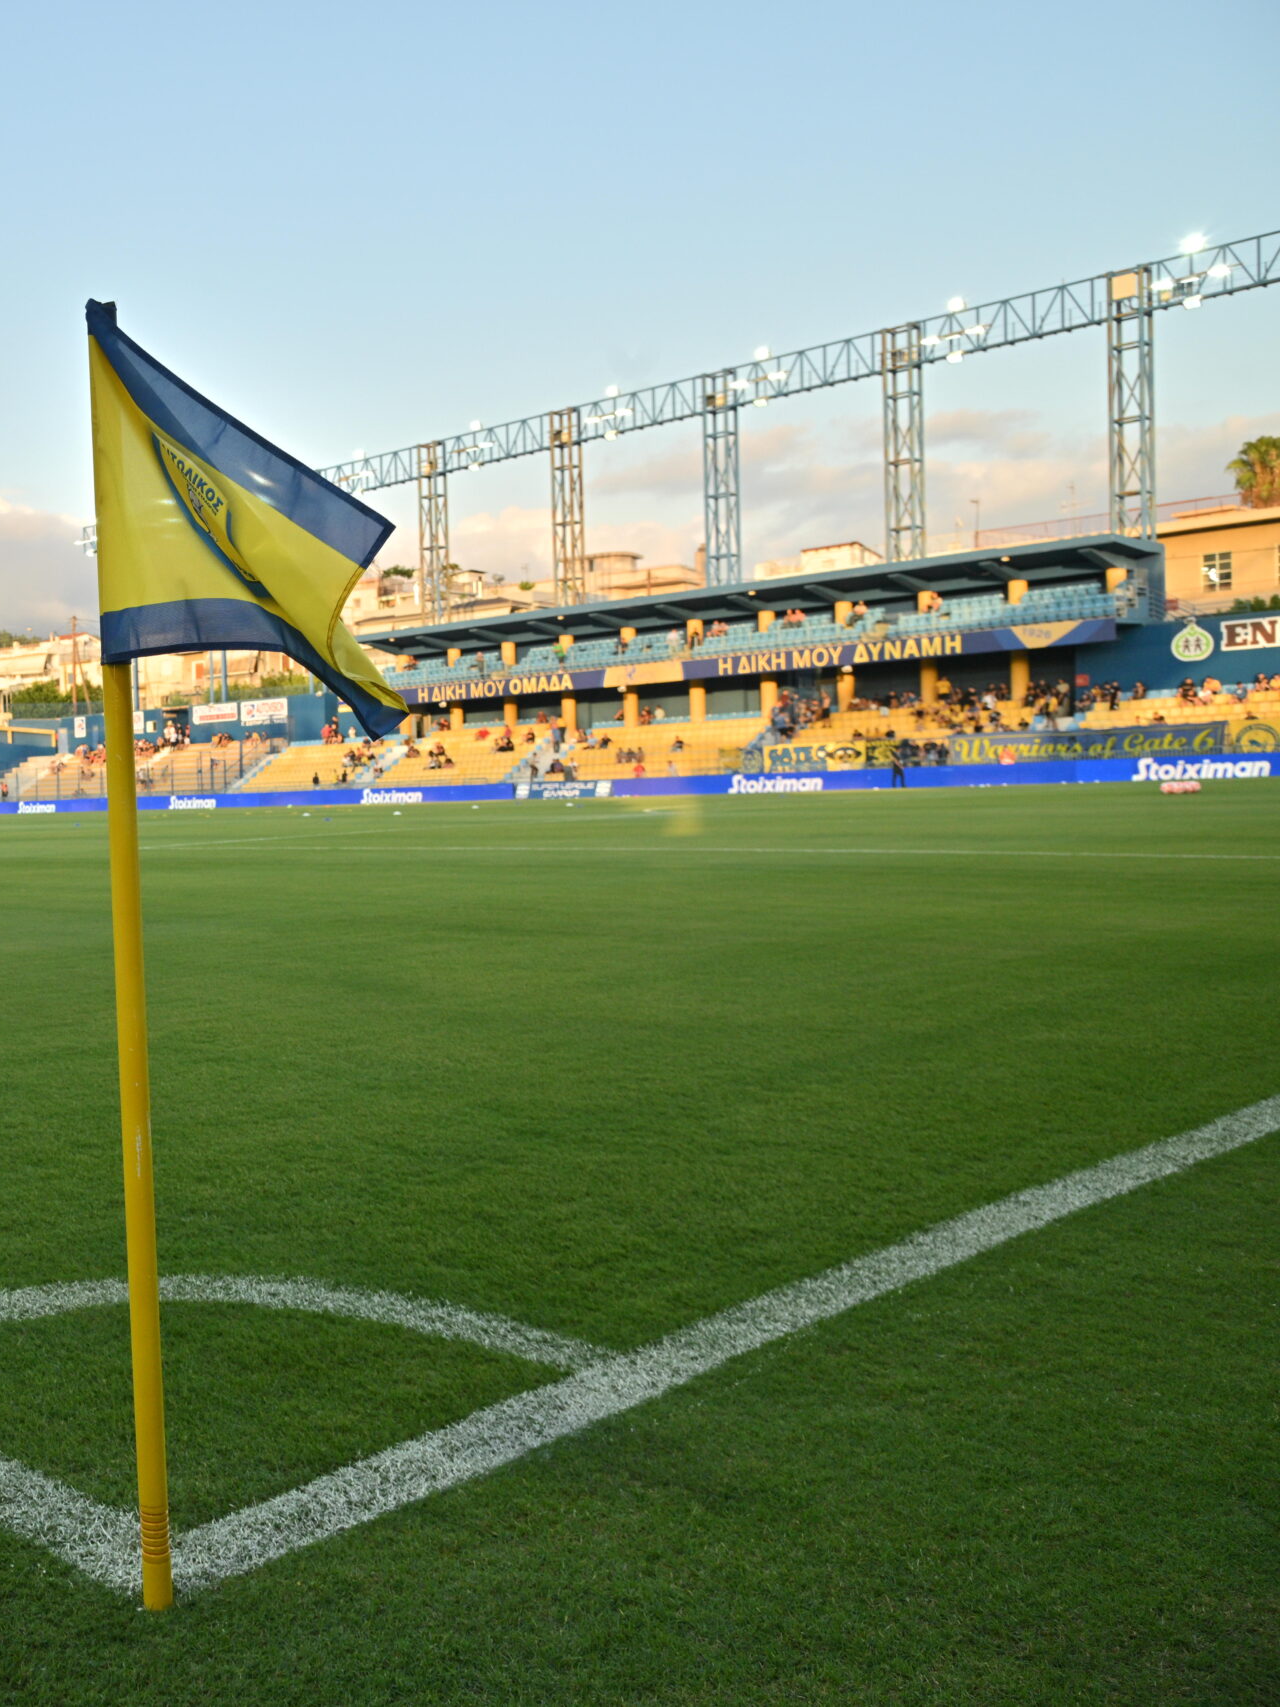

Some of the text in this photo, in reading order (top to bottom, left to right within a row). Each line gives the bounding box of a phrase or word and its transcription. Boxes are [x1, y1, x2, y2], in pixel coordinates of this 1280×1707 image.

[1225, 621, 1278, 648] EN
[718, 635, 962, 675] Η ΔΙΚΗ ΜΟΥ ΔΥΝΑΜΗ
[418, 674, 573, 703] Η ΔΙΚΗ ΜΟΥ ΟΜΑΔΑ
[955, 739, 1082, 762] Warriors
[1088, 735, 1117, 759] of
[1123, 732, 1179, 753] Gate
[1193, 728, 1215, 750] 6
[1132, 757, 1271, 781] Stoiximan
[728, 774, 823, 794] Stoiximan
[17, 801, 56, 814] Stoiximan
[168, 795, 216, 810] Stoiximan
[360, 788, 422, 805] Stoiximan
